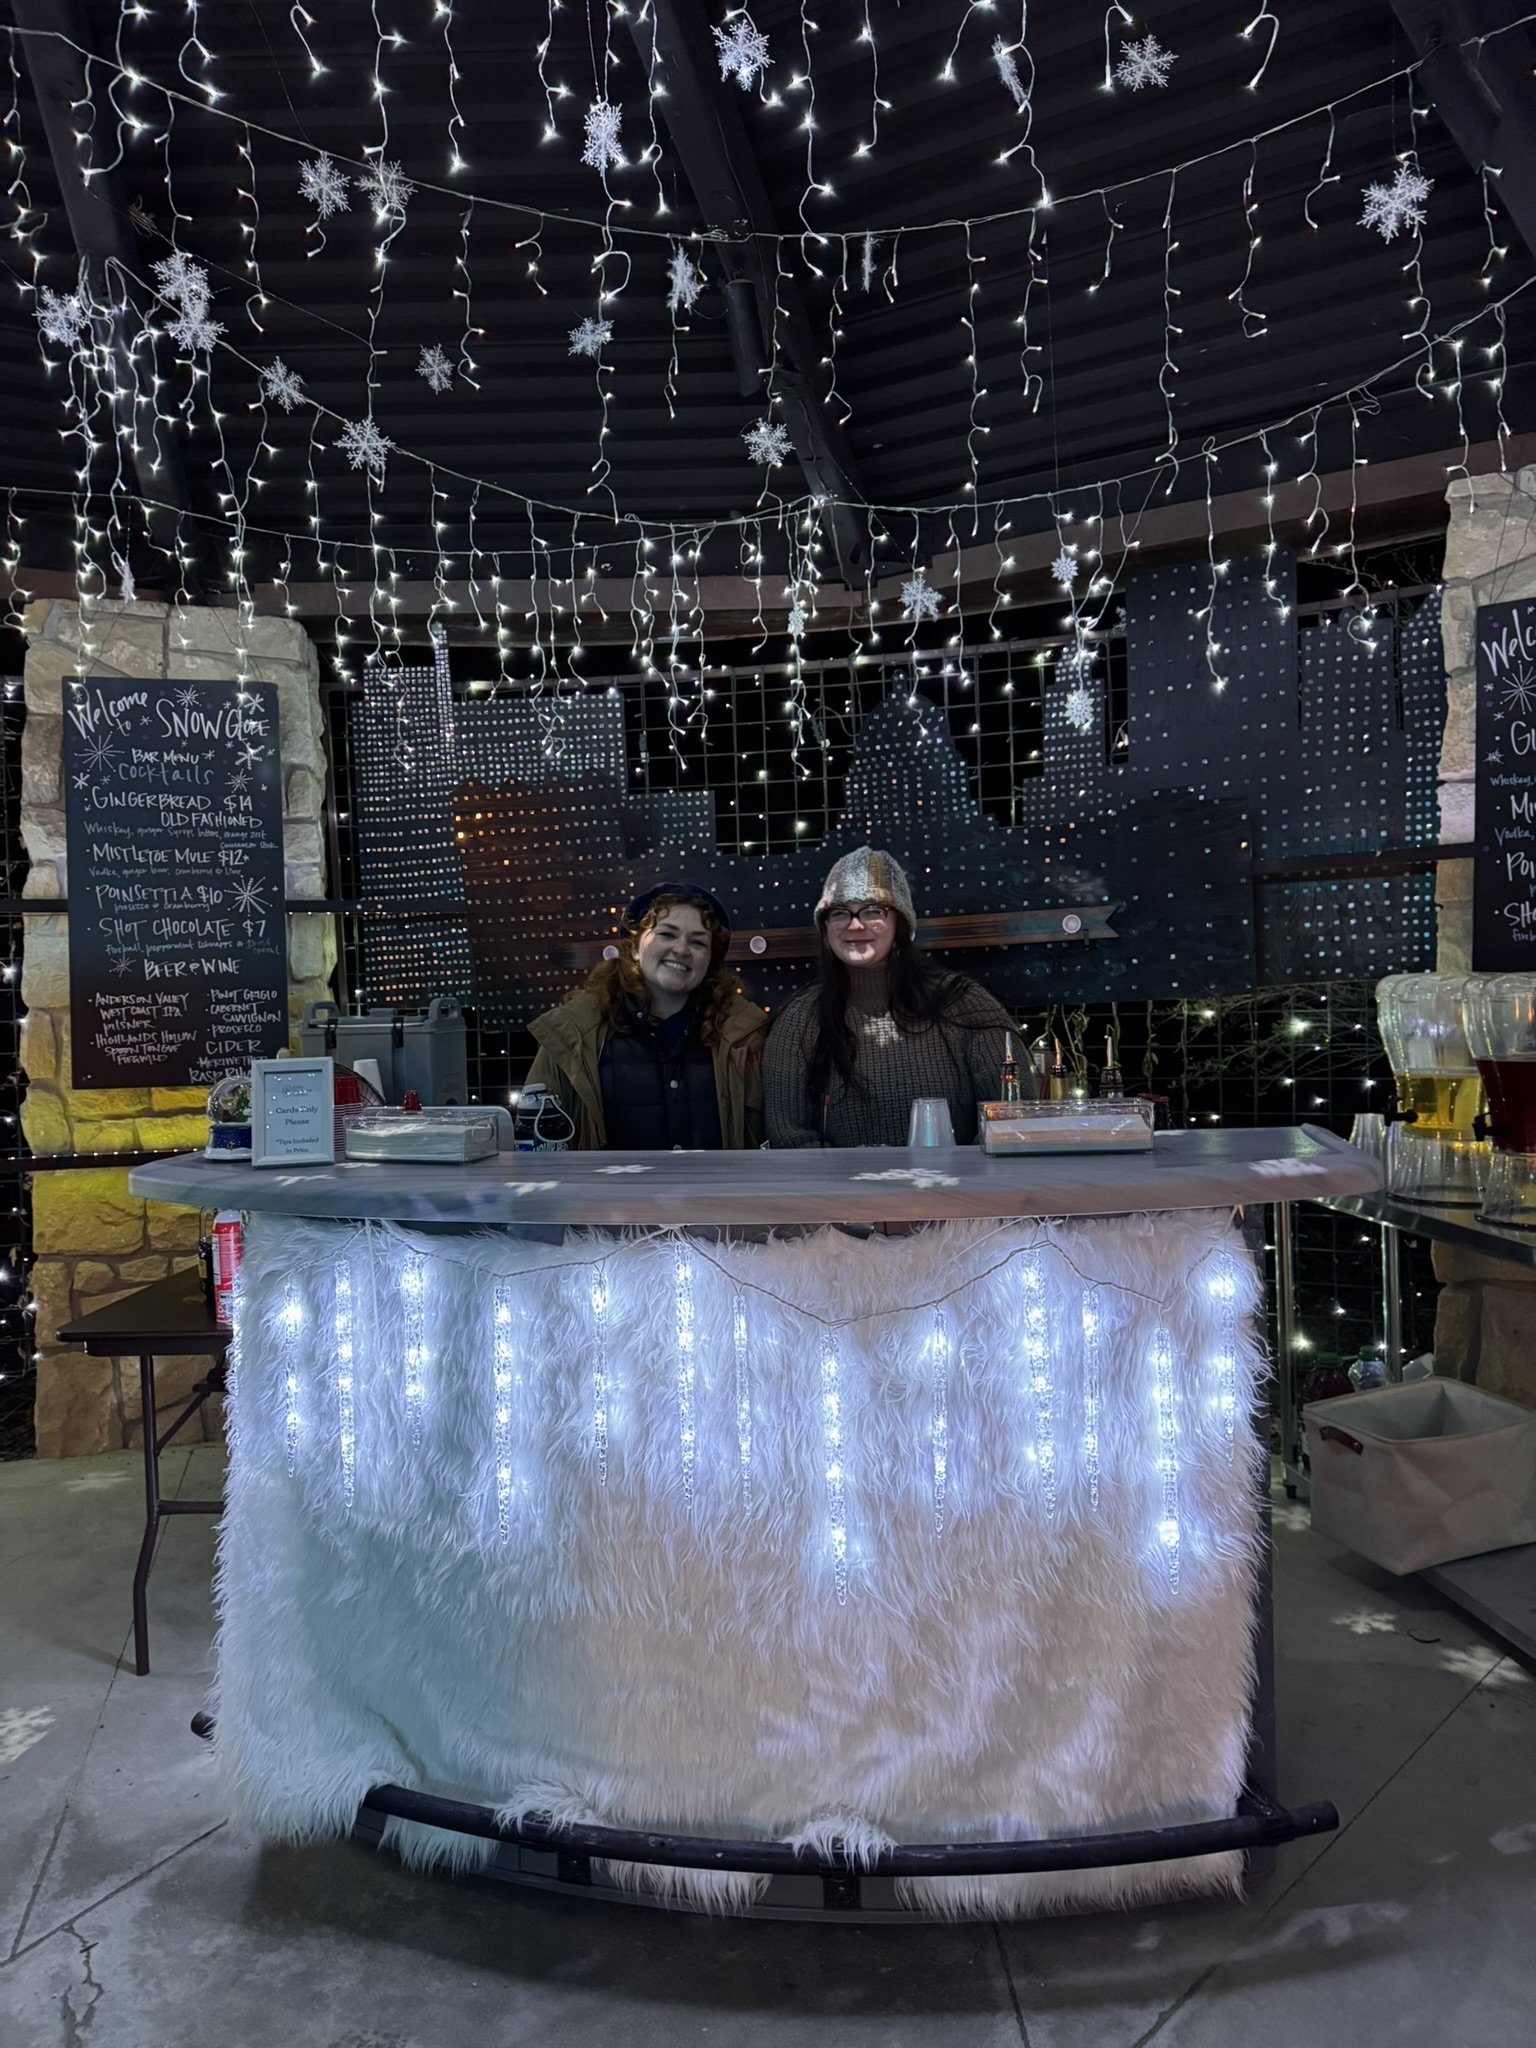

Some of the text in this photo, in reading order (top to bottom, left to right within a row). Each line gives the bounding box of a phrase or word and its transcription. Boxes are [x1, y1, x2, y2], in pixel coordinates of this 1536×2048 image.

[67, 688, 149, 740] Welcome
[115, 718, 132, 737] to
[131, 747, 200, 767] BAR MENU
[118, 762, 215, 787] Cocktails
[92, 785, 253, 814] GINGERBREAD $14
[1510, 791, 1536, 823] MI
[160, 810, 264, 830] OLD FASHIONED
[92, 842, 245, 867] MISTLETOE MULE $12
[95, 883, 223, 910] POINSETTIA $10
[98, 916, 266, 945] SHOT CHOCOLATE $7
[143, 958, 188, 981] BEER
[200, 956, 242, 976] WINE
[95, 991, 189, 1012] ANDERSON VALLEY
[210, 988, 278, 1004] PINOT GRIGIO
[100, 1005, 183, 1021] WEST COAST IPA
[210, 1001, 265, 1017] CABERNET
[222, 1009, 282, 1024] SAUVIGNON
[95, 1029, 198, 1049] HIGHLANDS HOLLOW
[211, 1023, 262, 1039] PROSECCO
[205, 1039, 265, 1055] CIDER
[275, 1106, 299, 1114] Cards
[284, 1118, 310, 1126] Please
